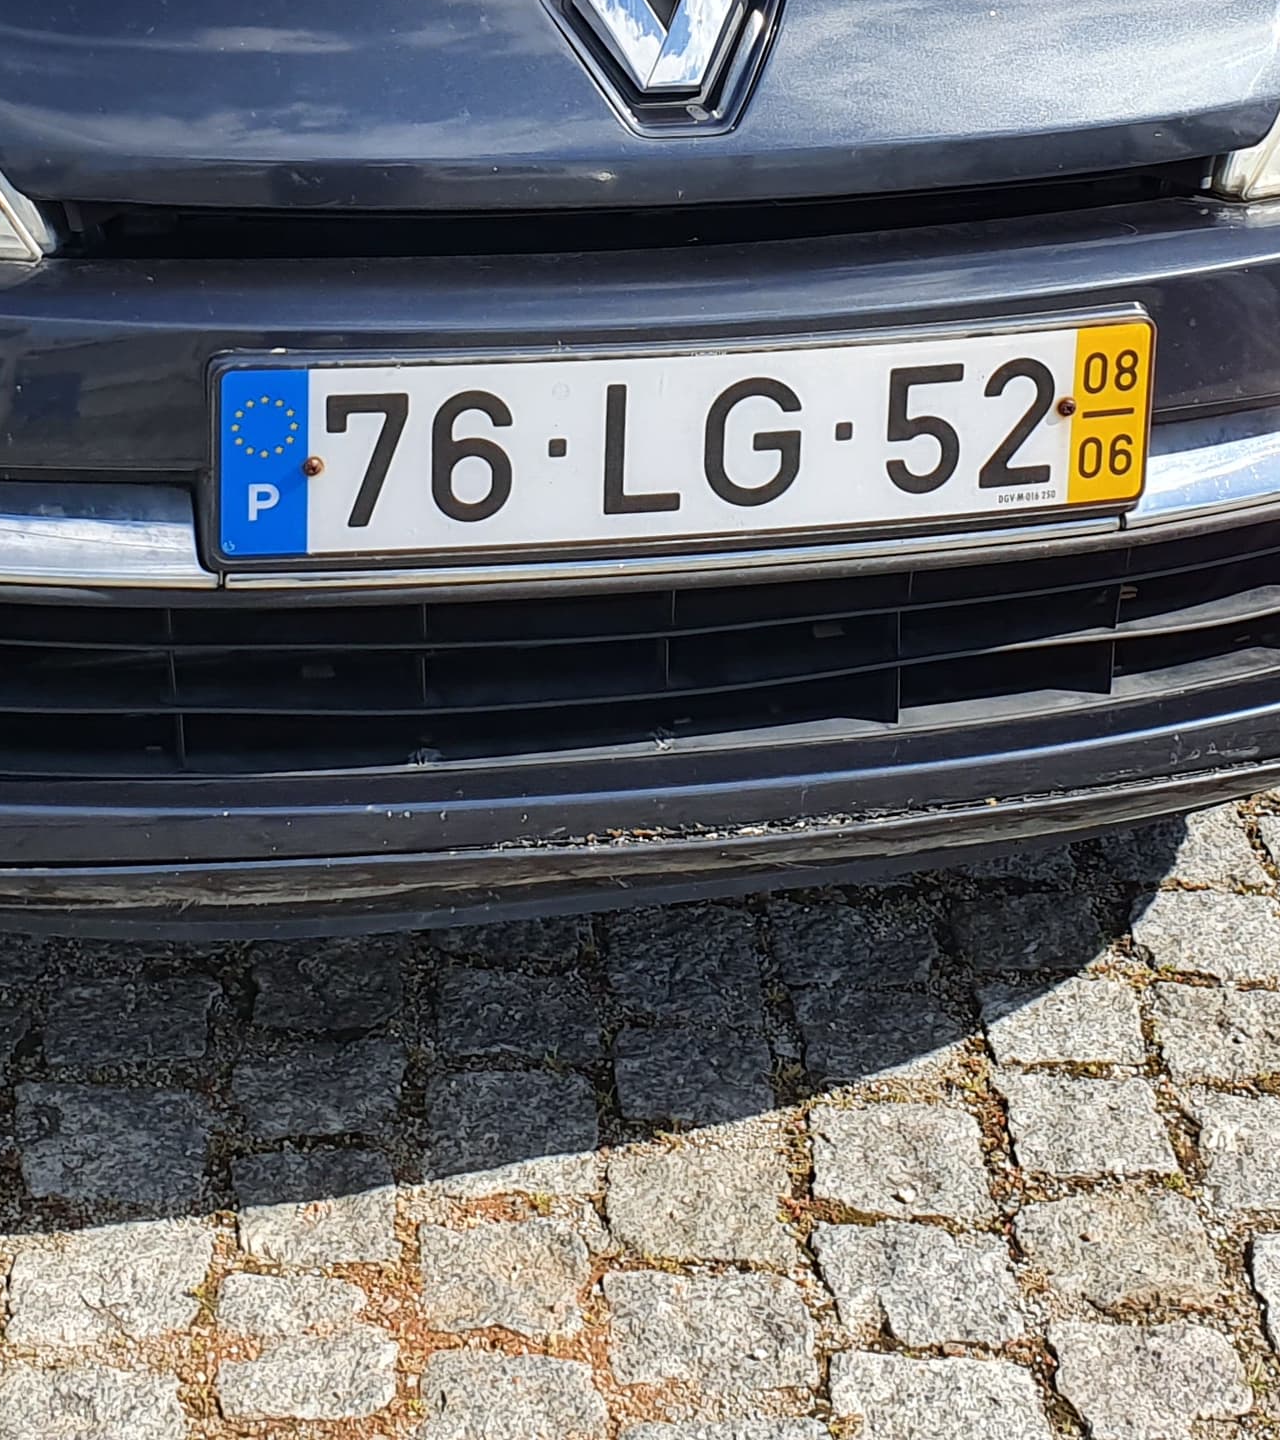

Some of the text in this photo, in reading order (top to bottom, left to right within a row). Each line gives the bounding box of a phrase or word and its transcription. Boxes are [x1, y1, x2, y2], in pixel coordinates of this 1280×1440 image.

[1083, 349, 1139, 394] 08
[1078, 433, 1133, 479] 06
[248, 483, 280, 522] P
